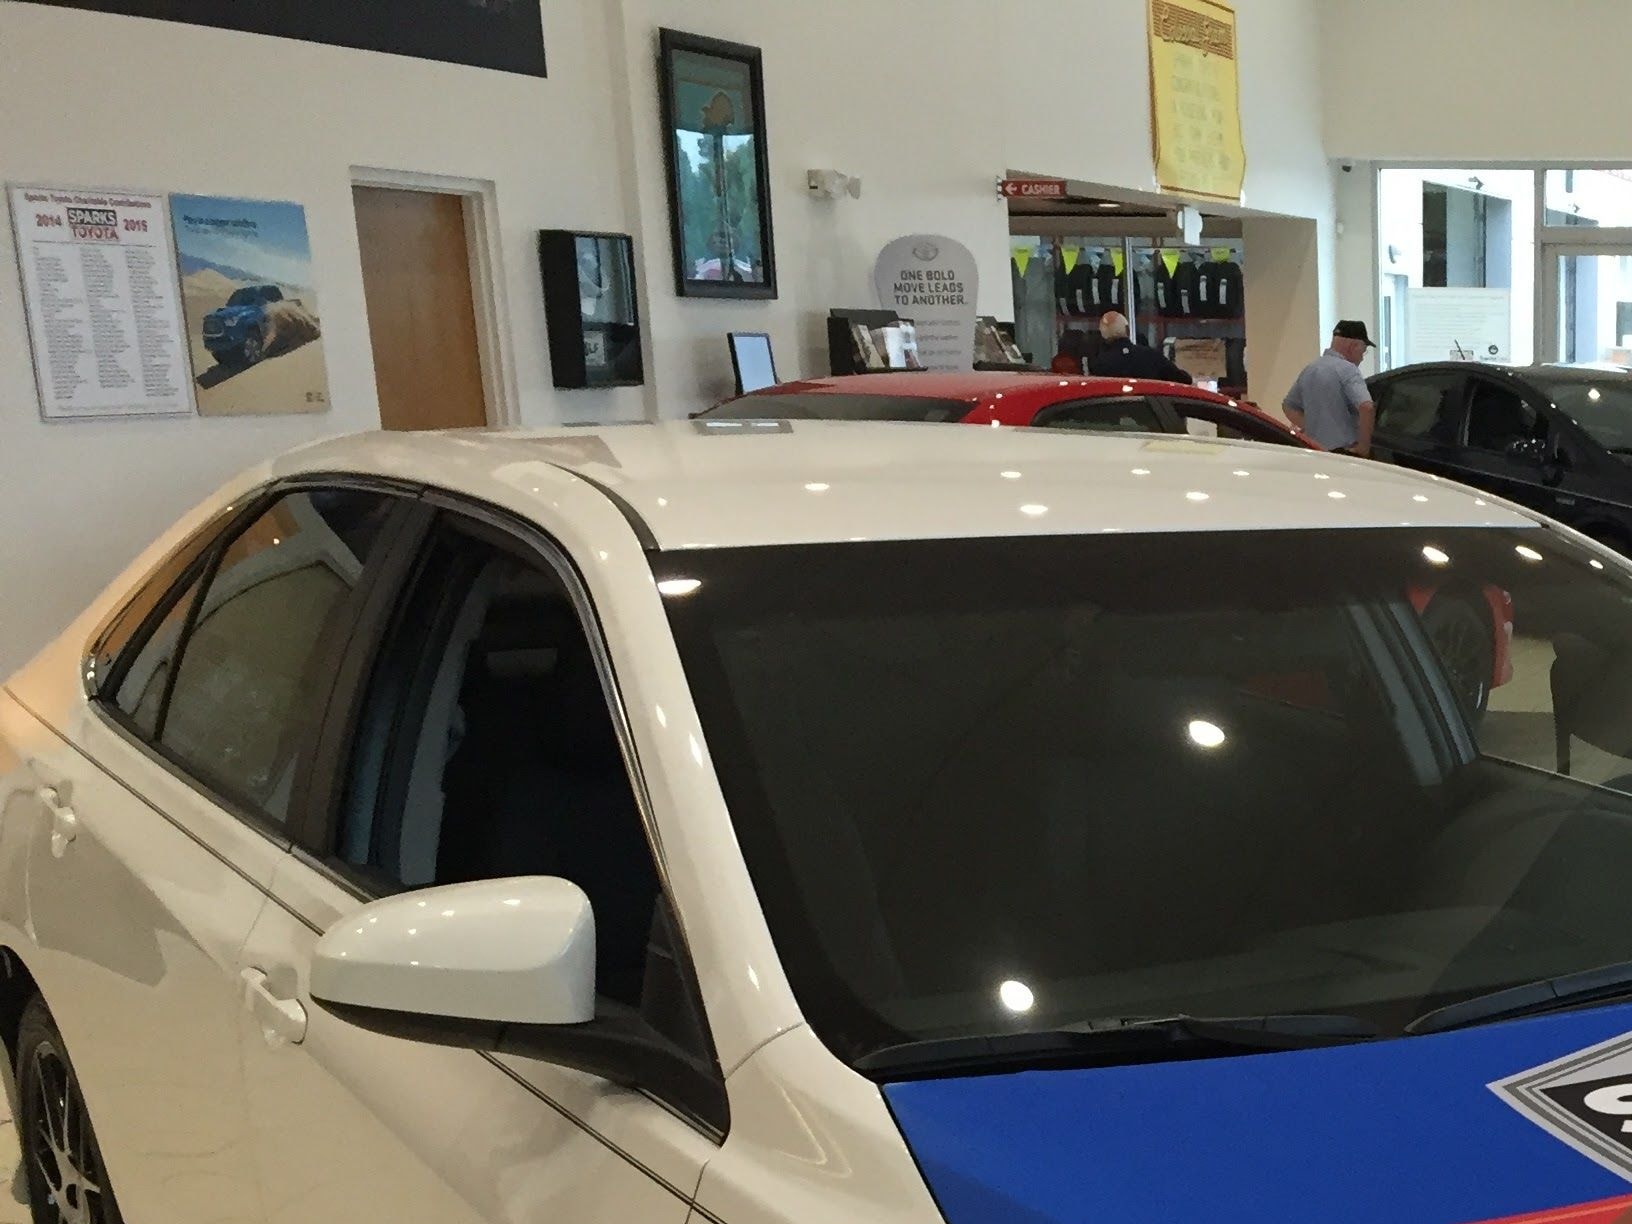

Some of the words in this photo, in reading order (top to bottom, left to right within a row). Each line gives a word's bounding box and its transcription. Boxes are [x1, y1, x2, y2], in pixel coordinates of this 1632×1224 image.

[1021, 184, 1061, 195] CASHIER
[36, 213, 62, 227] 2014
[68, 209, 117, 226] SPARKS
[72, 226, 119, 240] TOYOTA
[901, 270, 923, 281] ONE
[926, 270, 955, 281] BOLD
[894, 282, 925, 293] MOVE
[928, 282, 964, 293] LEADS
[895, 295, 909, 305] TO
